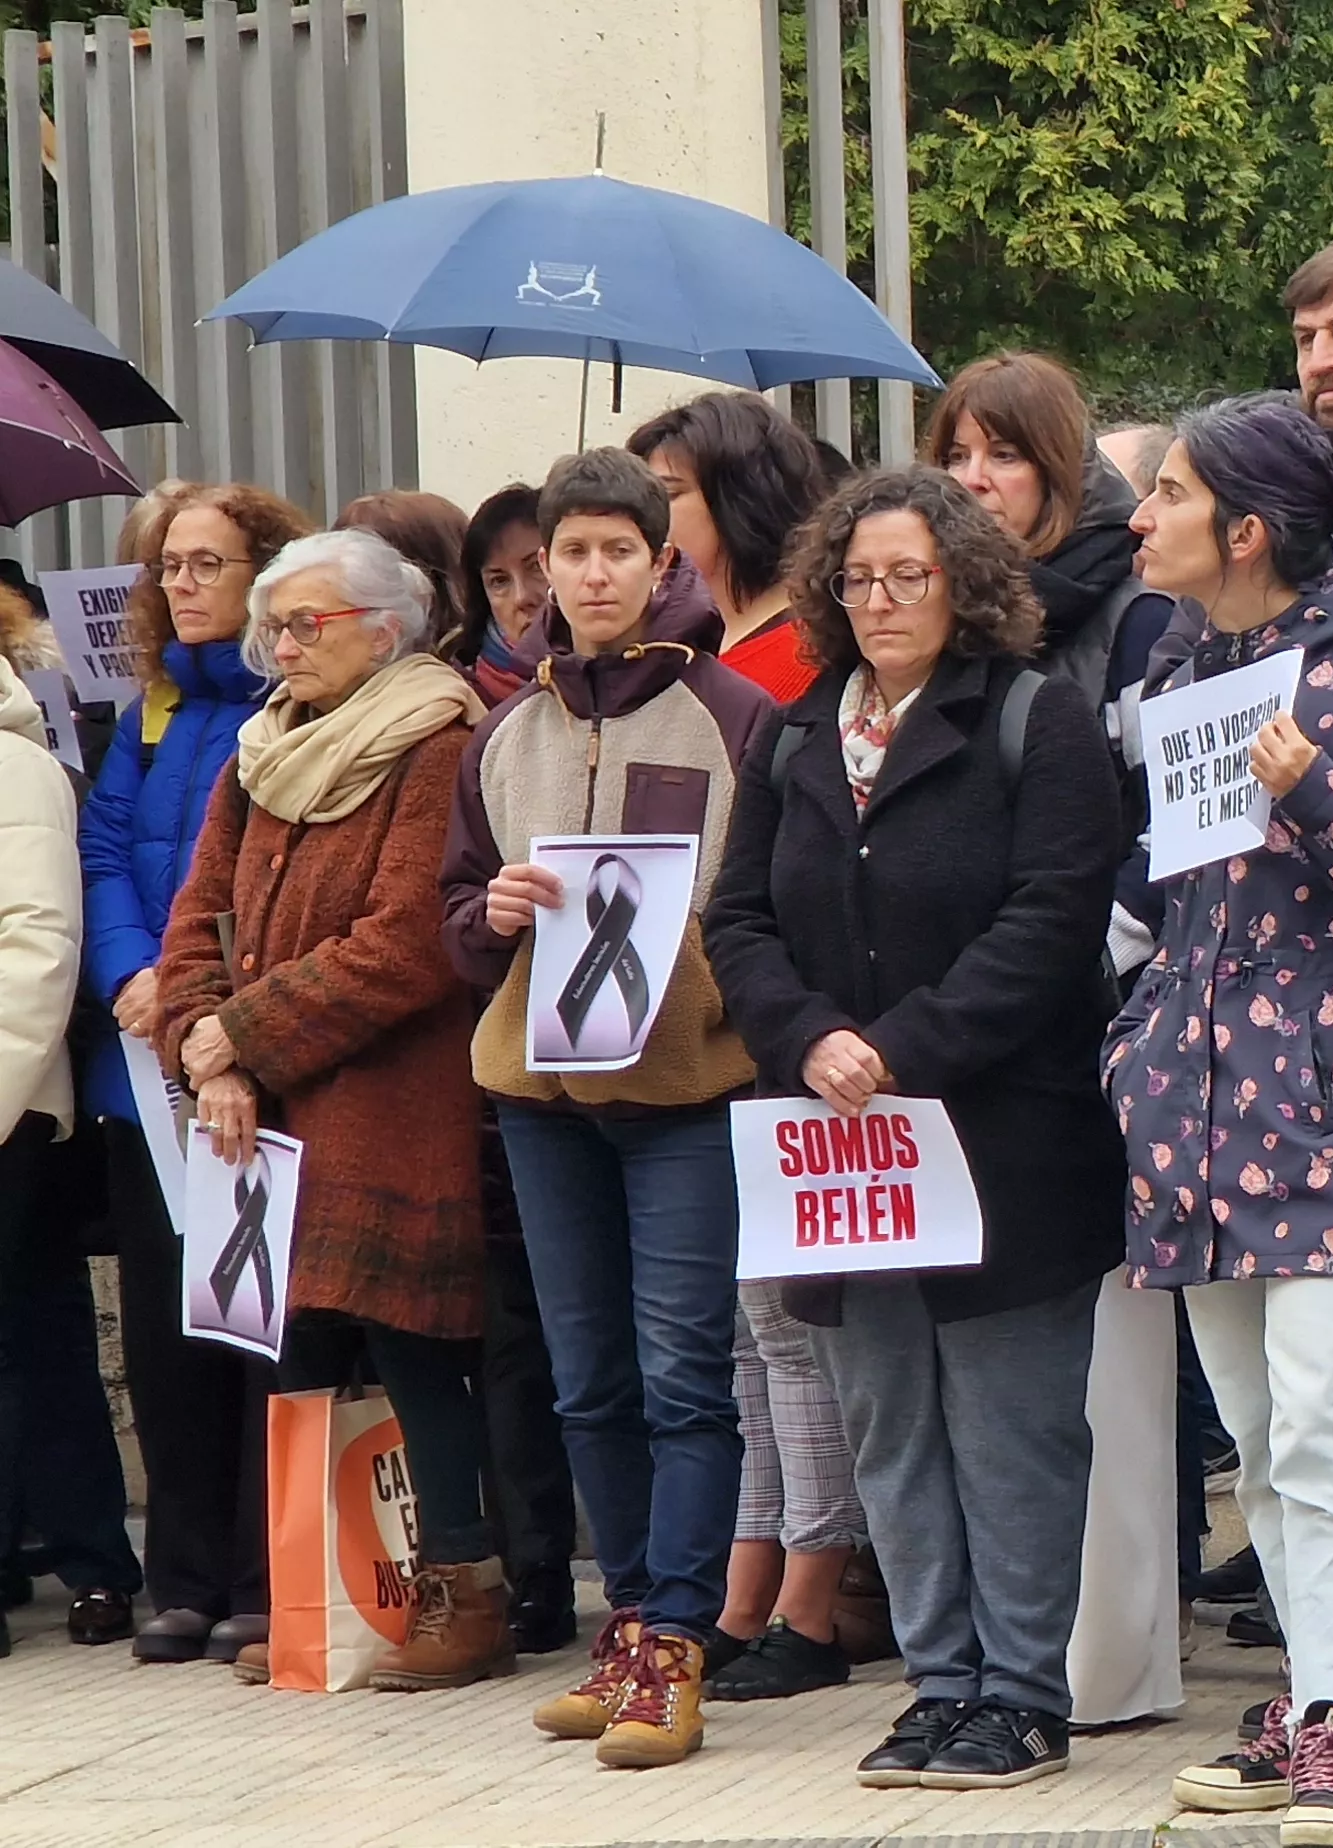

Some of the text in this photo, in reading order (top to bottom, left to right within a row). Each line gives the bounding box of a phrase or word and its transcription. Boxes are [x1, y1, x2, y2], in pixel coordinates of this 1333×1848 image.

[82, 654, 99, 679] Y
[1161, 729, 1193, 767] QUE
[1196, 721, 1216, 755] LA
[1164, 744, 1252, 804] NO SE ROMP
[1198, 798, 1213, 830] EL
[776, 1113, 919, 1177] SOMOS
[795, 1174, 916, 1247] BELÉN
